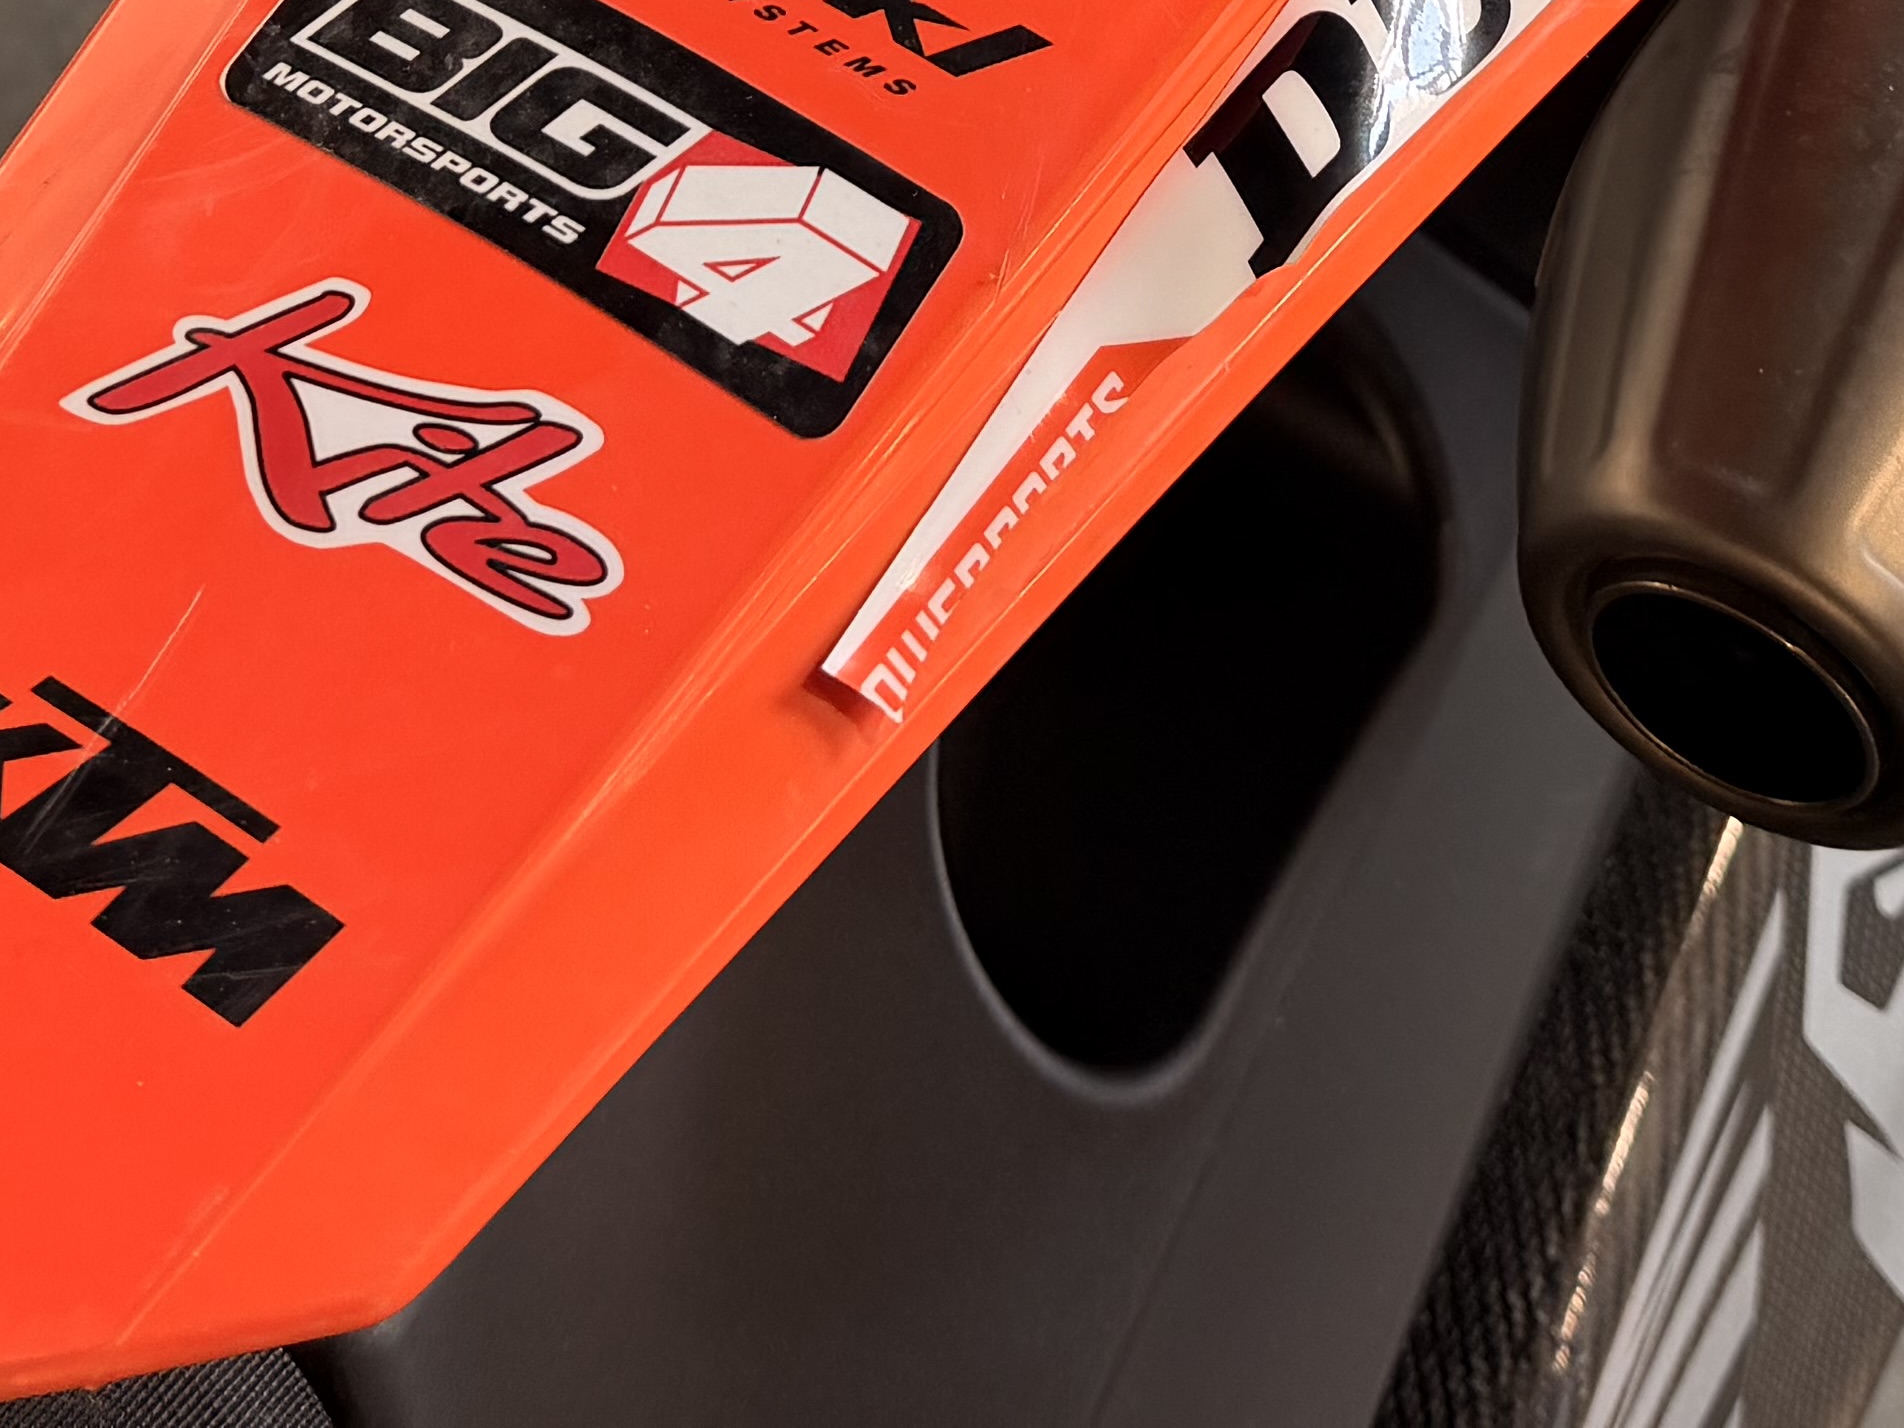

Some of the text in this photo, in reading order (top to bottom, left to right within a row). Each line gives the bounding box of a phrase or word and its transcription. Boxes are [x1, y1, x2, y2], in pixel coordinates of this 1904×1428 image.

[262, 60, 586, 246] MOTORSPORTS
[624, 163, 911, 347] 4
[86, 288, 612, 624] Kite
